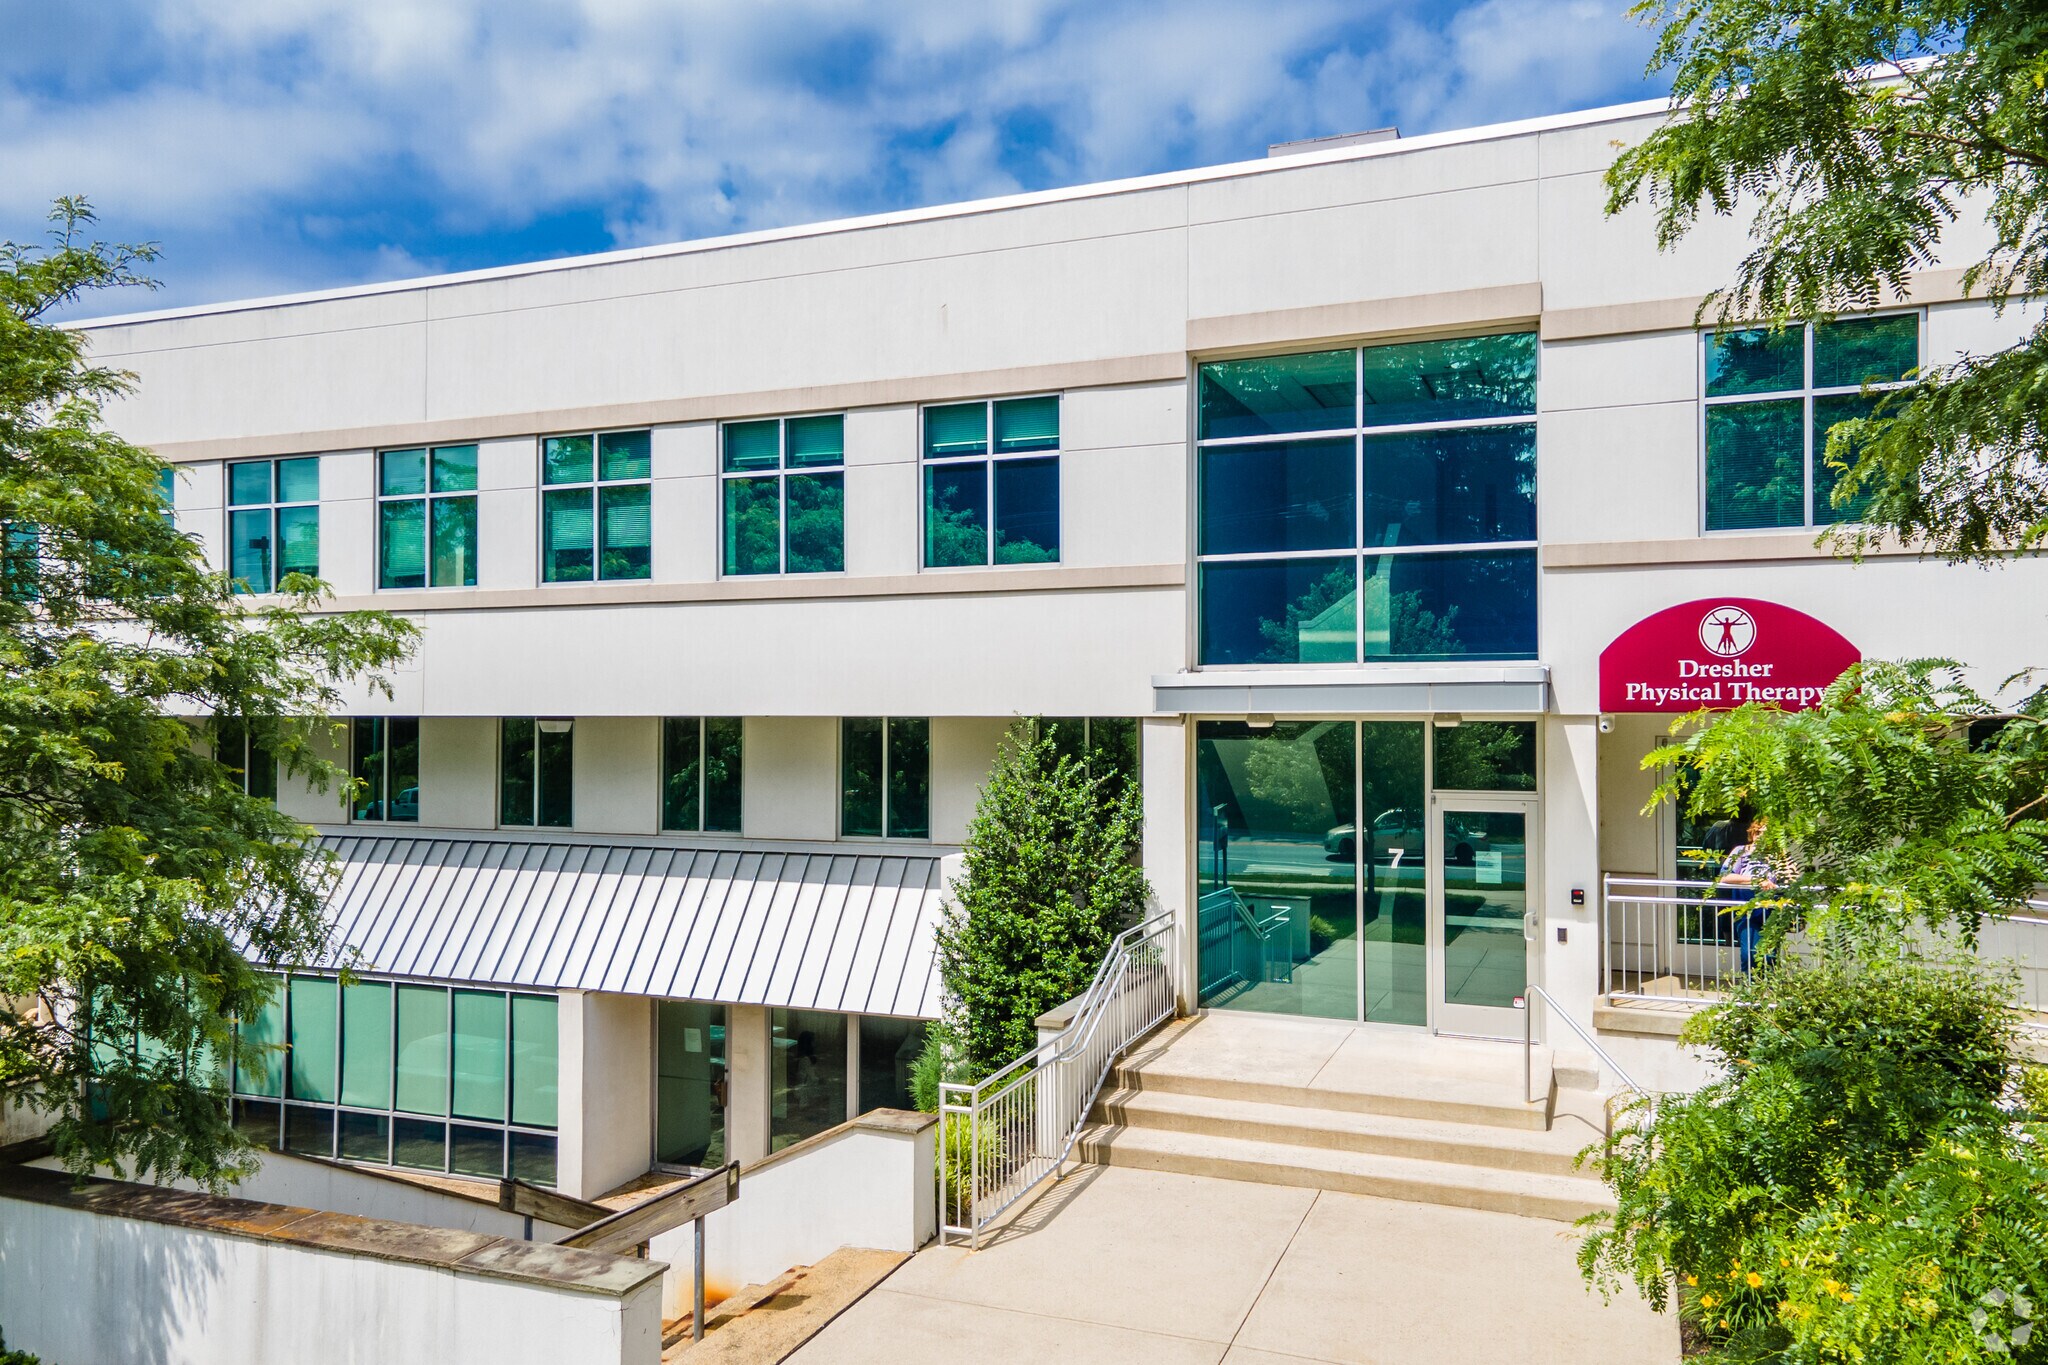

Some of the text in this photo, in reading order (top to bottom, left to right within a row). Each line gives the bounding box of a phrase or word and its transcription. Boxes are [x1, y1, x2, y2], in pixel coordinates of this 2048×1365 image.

[1678, 659, 1773, 678] Dresher
[1625, 682, 1827, 706] Physical Therapy
[1388, 848, 1404, 868] 7
